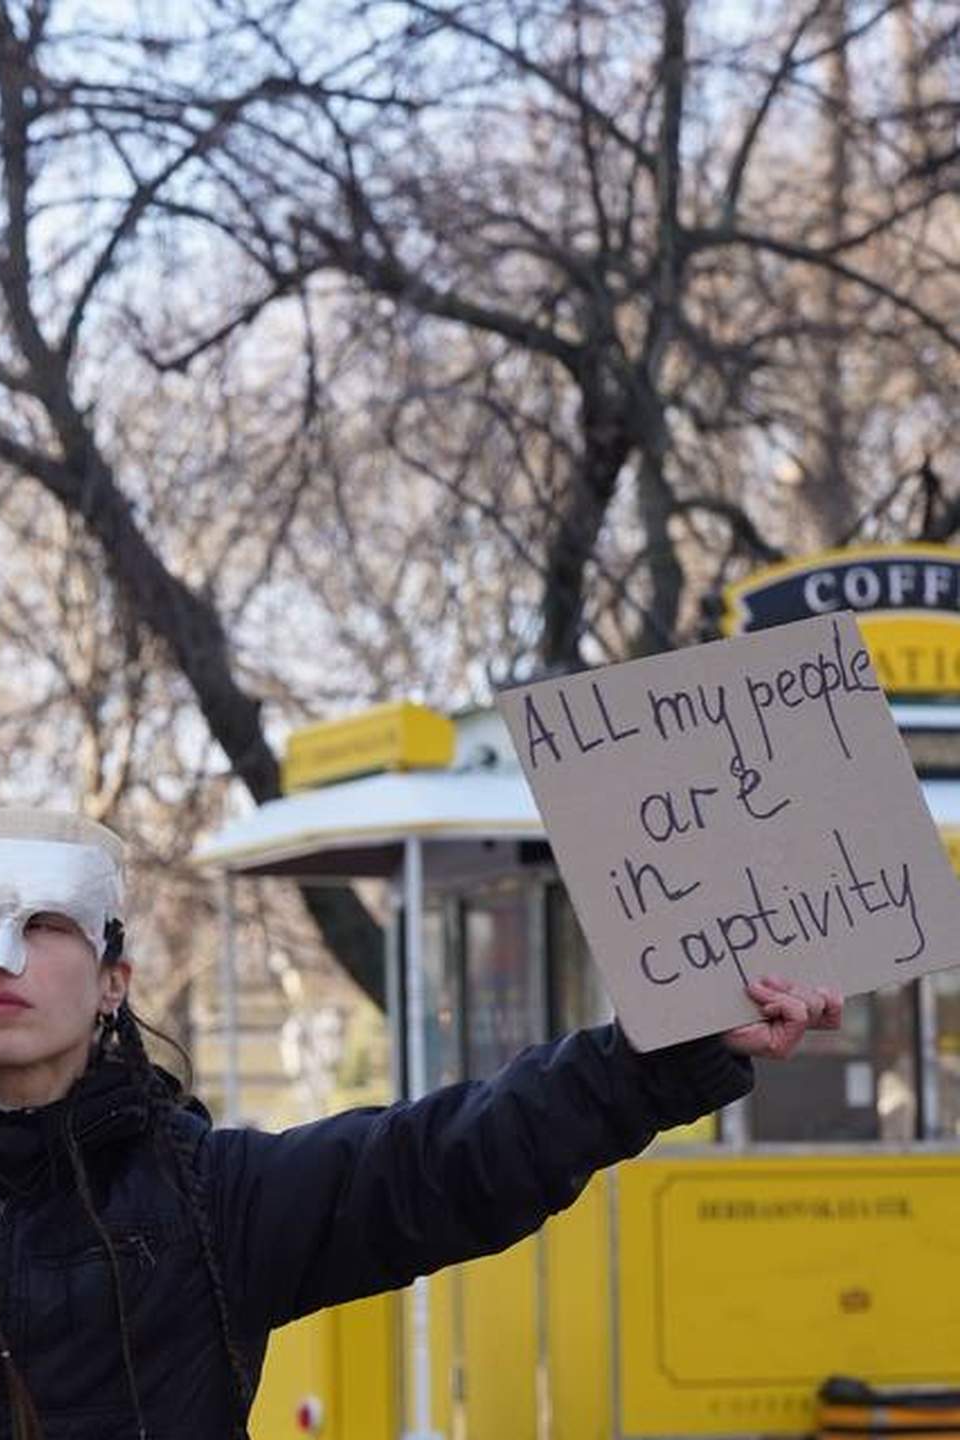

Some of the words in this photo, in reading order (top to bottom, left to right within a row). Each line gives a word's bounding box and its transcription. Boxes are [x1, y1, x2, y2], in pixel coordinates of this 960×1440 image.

[804, 565, 960, 614] COFF
[524, 683, 639, 769] ALL
[648, 685, 746, 778] my
[746, 621, 879, 761] people
[640, 767, 791, 842] are
[609, 858, 701, 920] in
[640, 829, 925, 987] captivity
